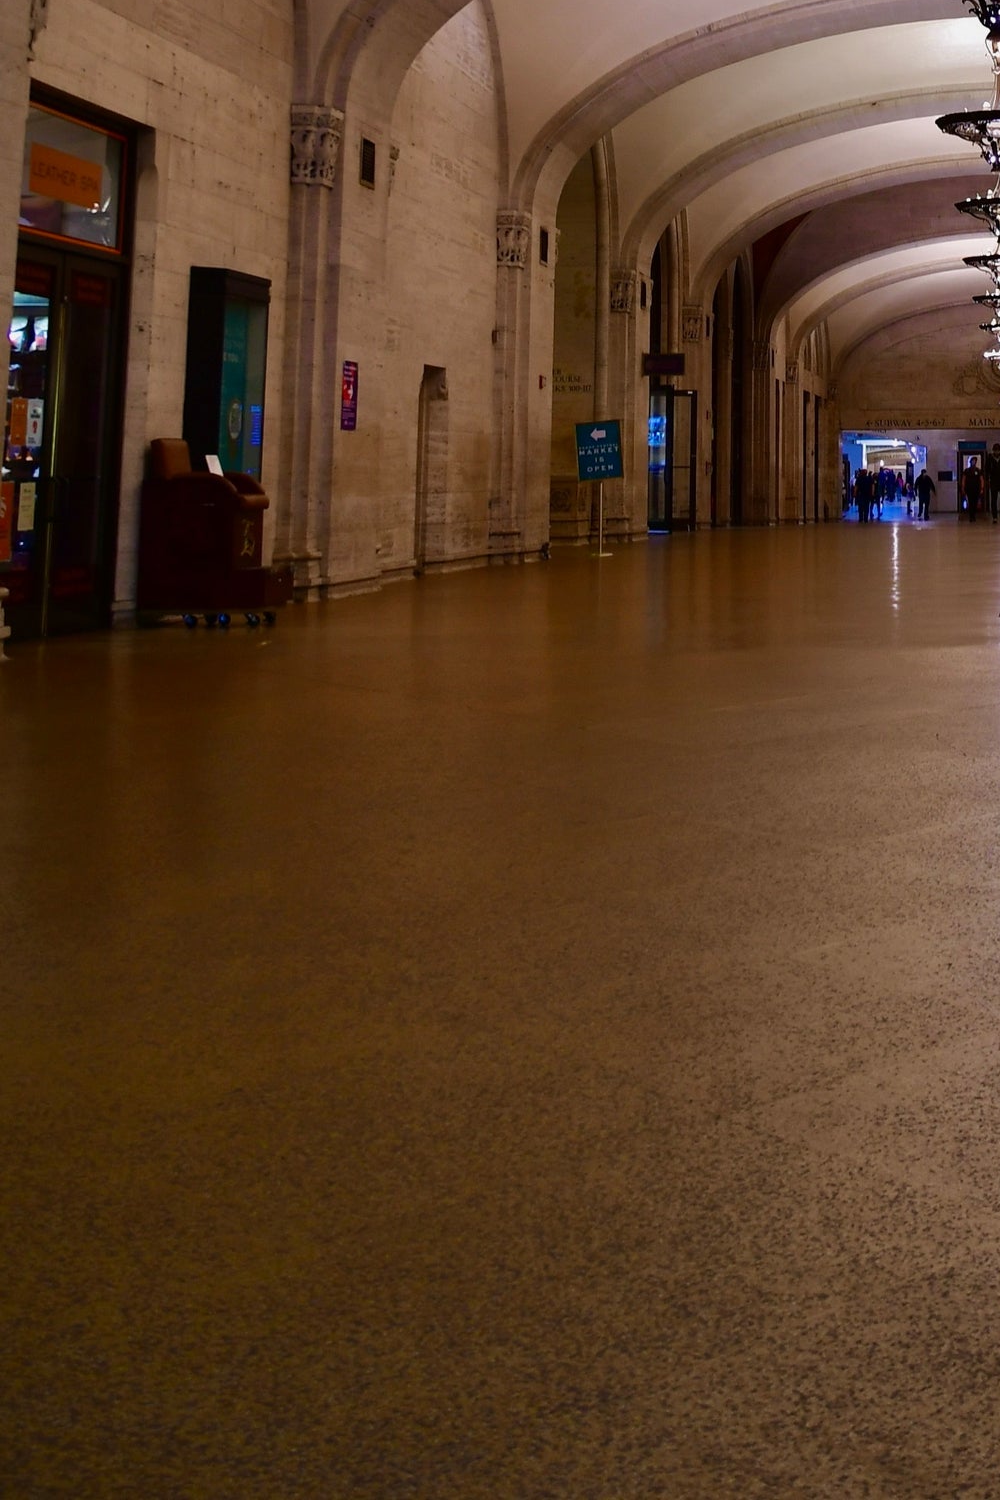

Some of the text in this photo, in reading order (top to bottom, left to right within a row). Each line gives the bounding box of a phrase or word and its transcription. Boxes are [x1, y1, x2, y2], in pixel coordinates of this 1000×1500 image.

[32, 161, 77, 187] LEATHER
[874, 419, 912, 427] SUBWAY
[968, 418, 995, 427] MAIN
[578, 446, 618, 456] MARKET
[586, 464, 614, 473] OPEN
